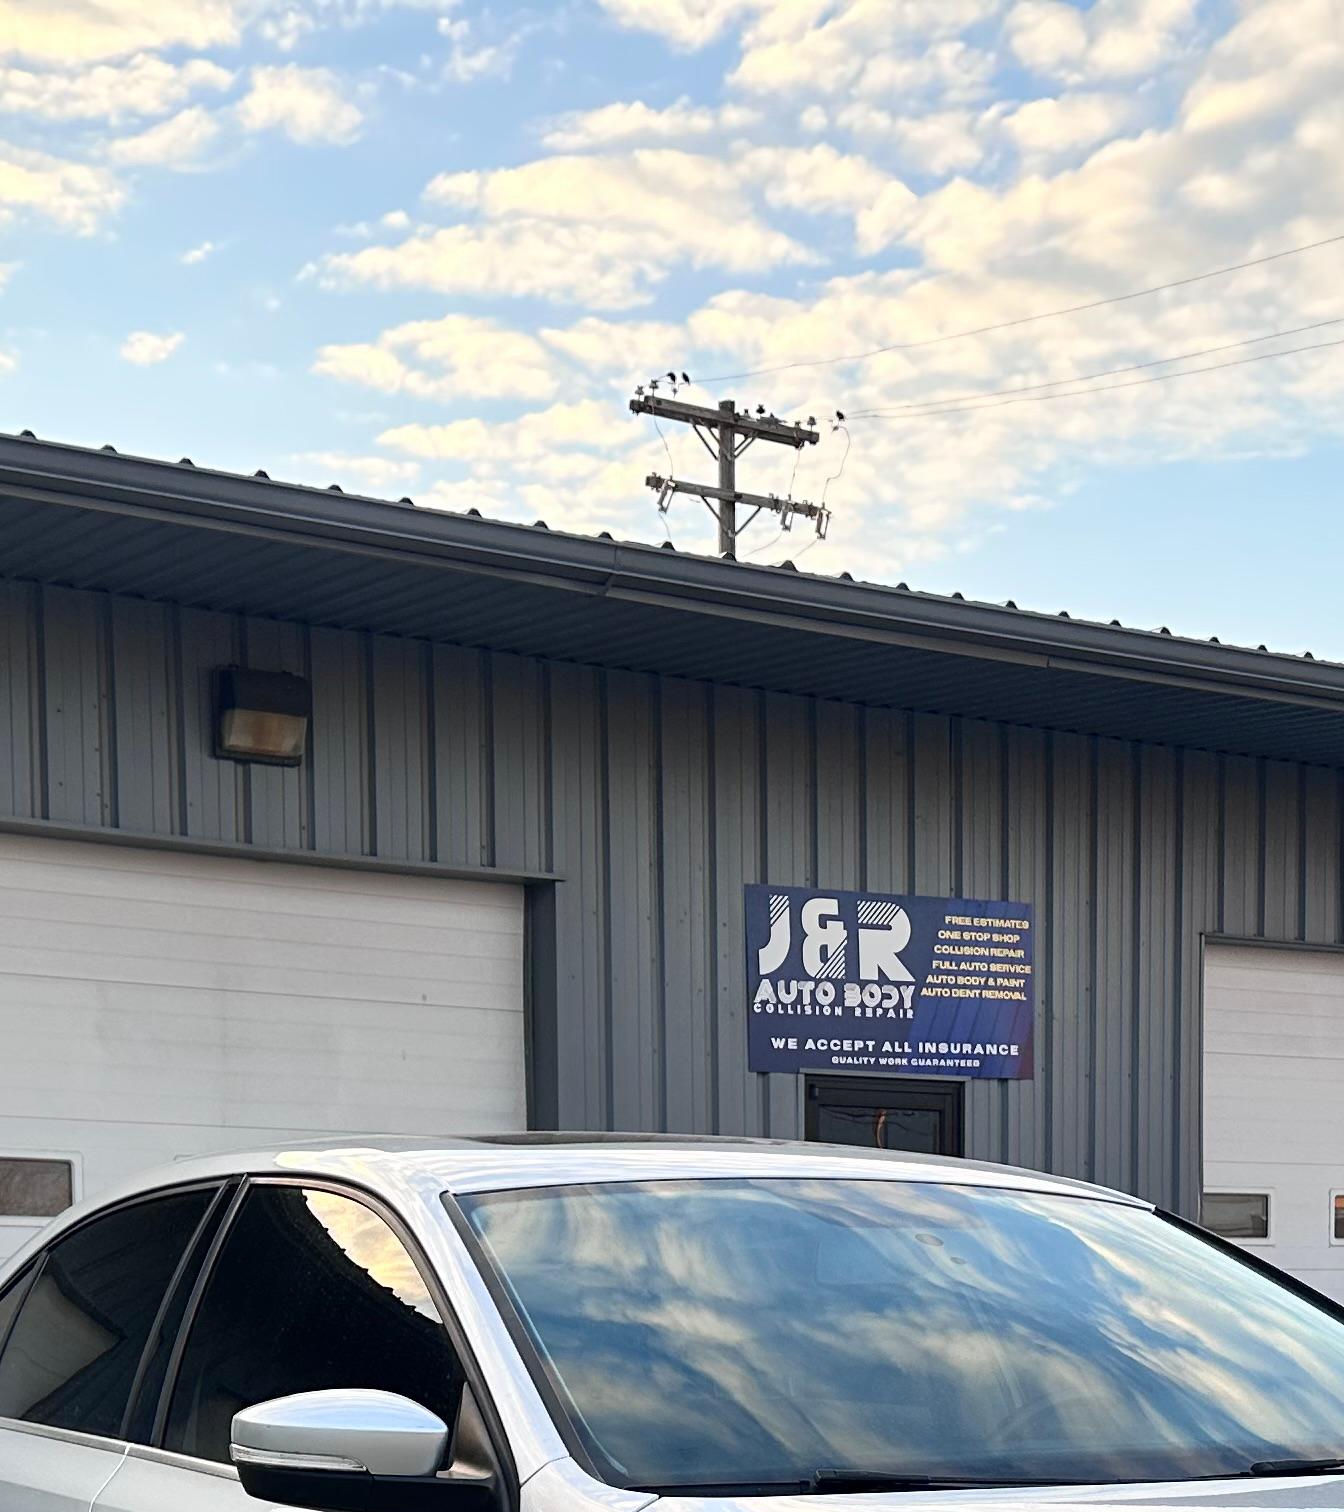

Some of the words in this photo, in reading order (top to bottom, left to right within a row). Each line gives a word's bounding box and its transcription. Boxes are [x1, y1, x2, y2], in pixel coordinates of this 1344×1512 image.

[945, 915, 972, 926] FREE
[973, 917, 1030, 930] ESTIMATES
[938, 930, 961, 940] ONE
[962, 931, 991, 941] STOP
[991, 933, 1021, 944] SHOP
[933, 944, 989, 956] COLLISION
[990, 947, 1025, 959] REPAIR
[932, 960, 958, 970] FULL
[959, 961, 988, 971] AUTO
[989, 963, 1031, 974] SERVICE
[926, 974, 955, 984] AUTO
[956, 976, 987, 986] BODY
[987, 977, 995, 986] &
[996, 977, 1026, 988] PAINT
[753, 978, 836, 1006] AUTO
[844, 982, 915, 1009] BODY
[920, 987, 950, 997] AUTO
[951, 988, 981, 998] DENT
[981, 990, 1027, 1001] REMOVAL
[753, 1003, 843, 1017] COLLISION
[854, 1007, 914, 1019] REPAIR
[770, 1037, 798, 1050] WE
[805, 1038, 876, 1053] ACCEPT
[881, 1041, 913, 1053] ALL
[918, 1042, 1019, 1056] INSURANCE
[831, 1056, 876, 1065] QUALITY
[878, 1057, 908, 1066] WORK
[910, 1058, 980, 1067] GUARANTEED
